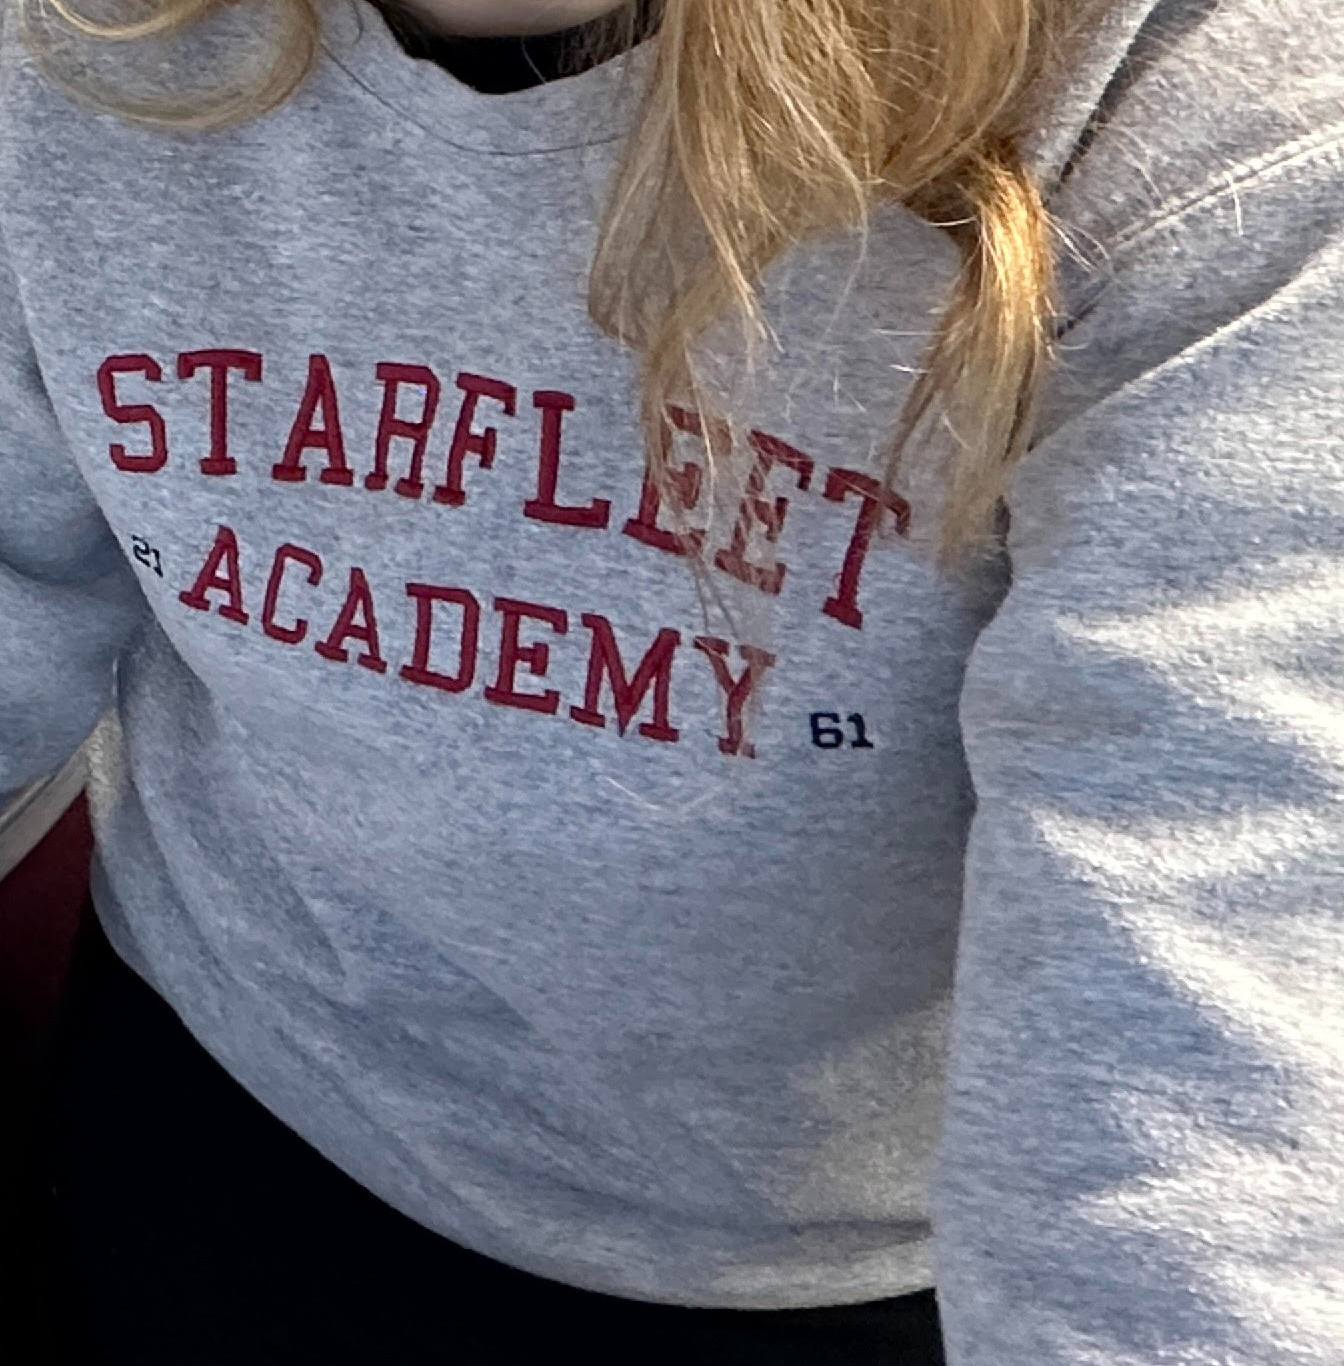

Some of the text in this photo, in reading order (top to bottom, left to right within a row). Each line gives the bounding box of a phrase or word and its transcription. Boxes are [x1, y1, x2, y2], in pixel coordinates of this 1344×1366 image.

[95, 347, 912, 631] STARFLEET
[130, 524, 875, 760] 21 ACADEMY 61
